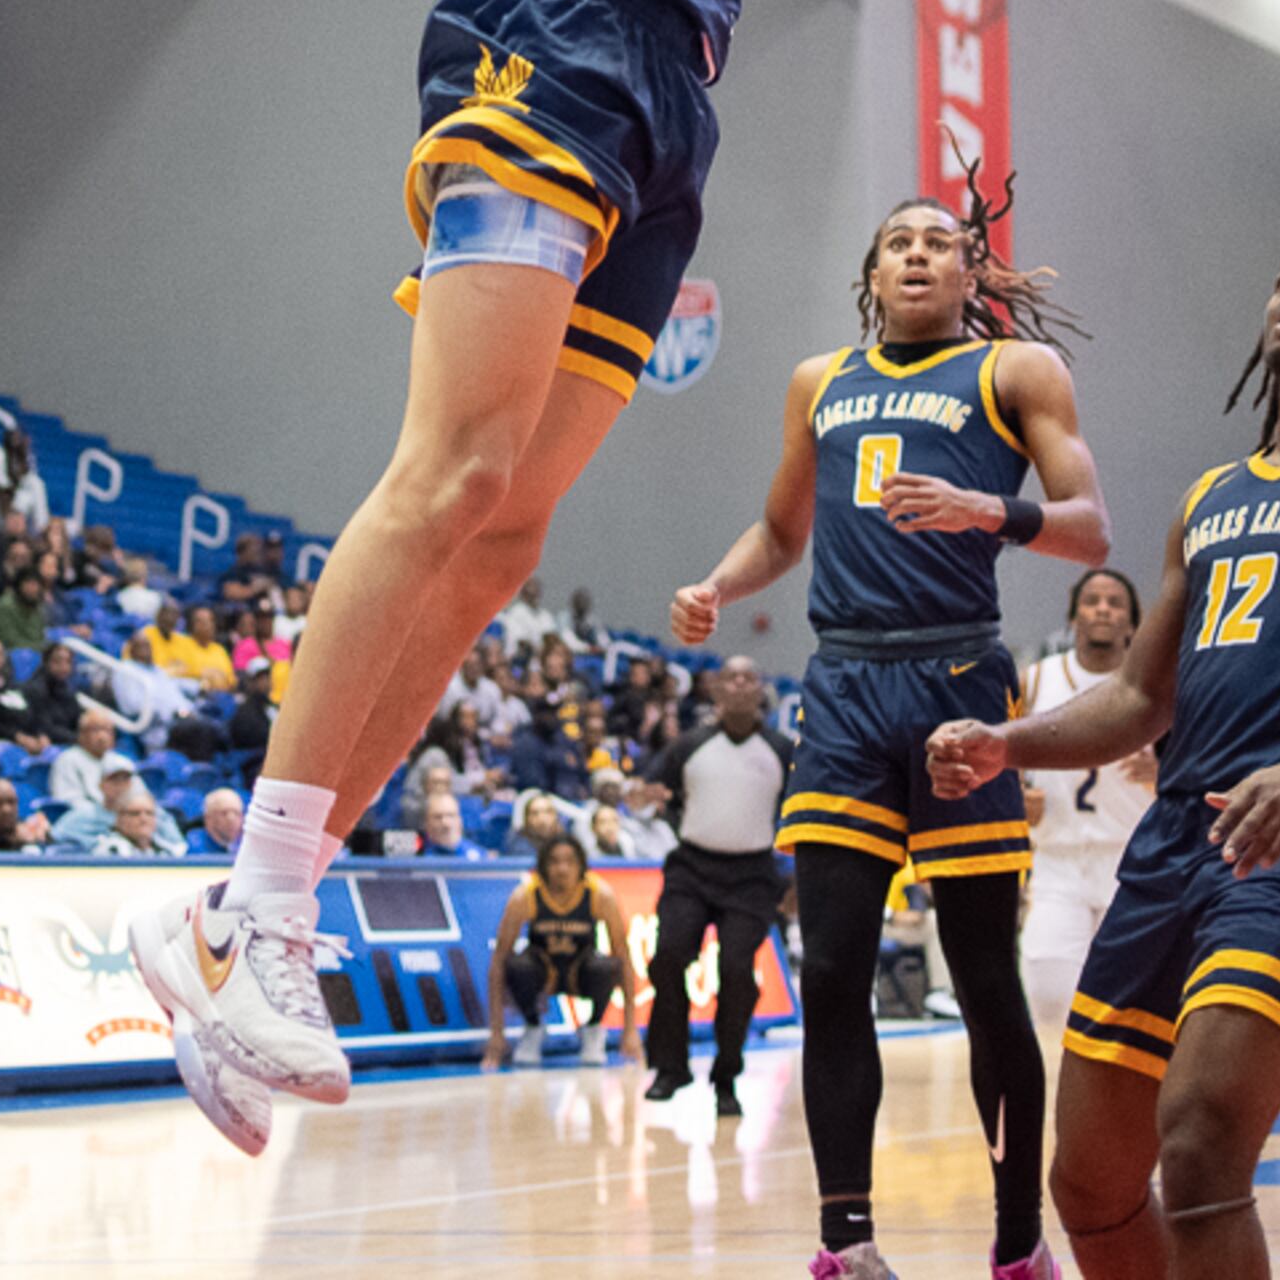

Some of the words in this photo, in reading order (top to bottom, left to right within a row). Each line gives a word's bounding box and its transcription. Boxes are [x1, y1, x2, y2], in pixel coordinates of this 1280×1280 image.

[815, 394, 878, 439] EAGLES
[882, 391, 973, 433] LANDING
[853, 430, 903, 508] 0
[1183, 505, 1249, 568] EAGLES
[1195, 551, 1279, 651] 12
